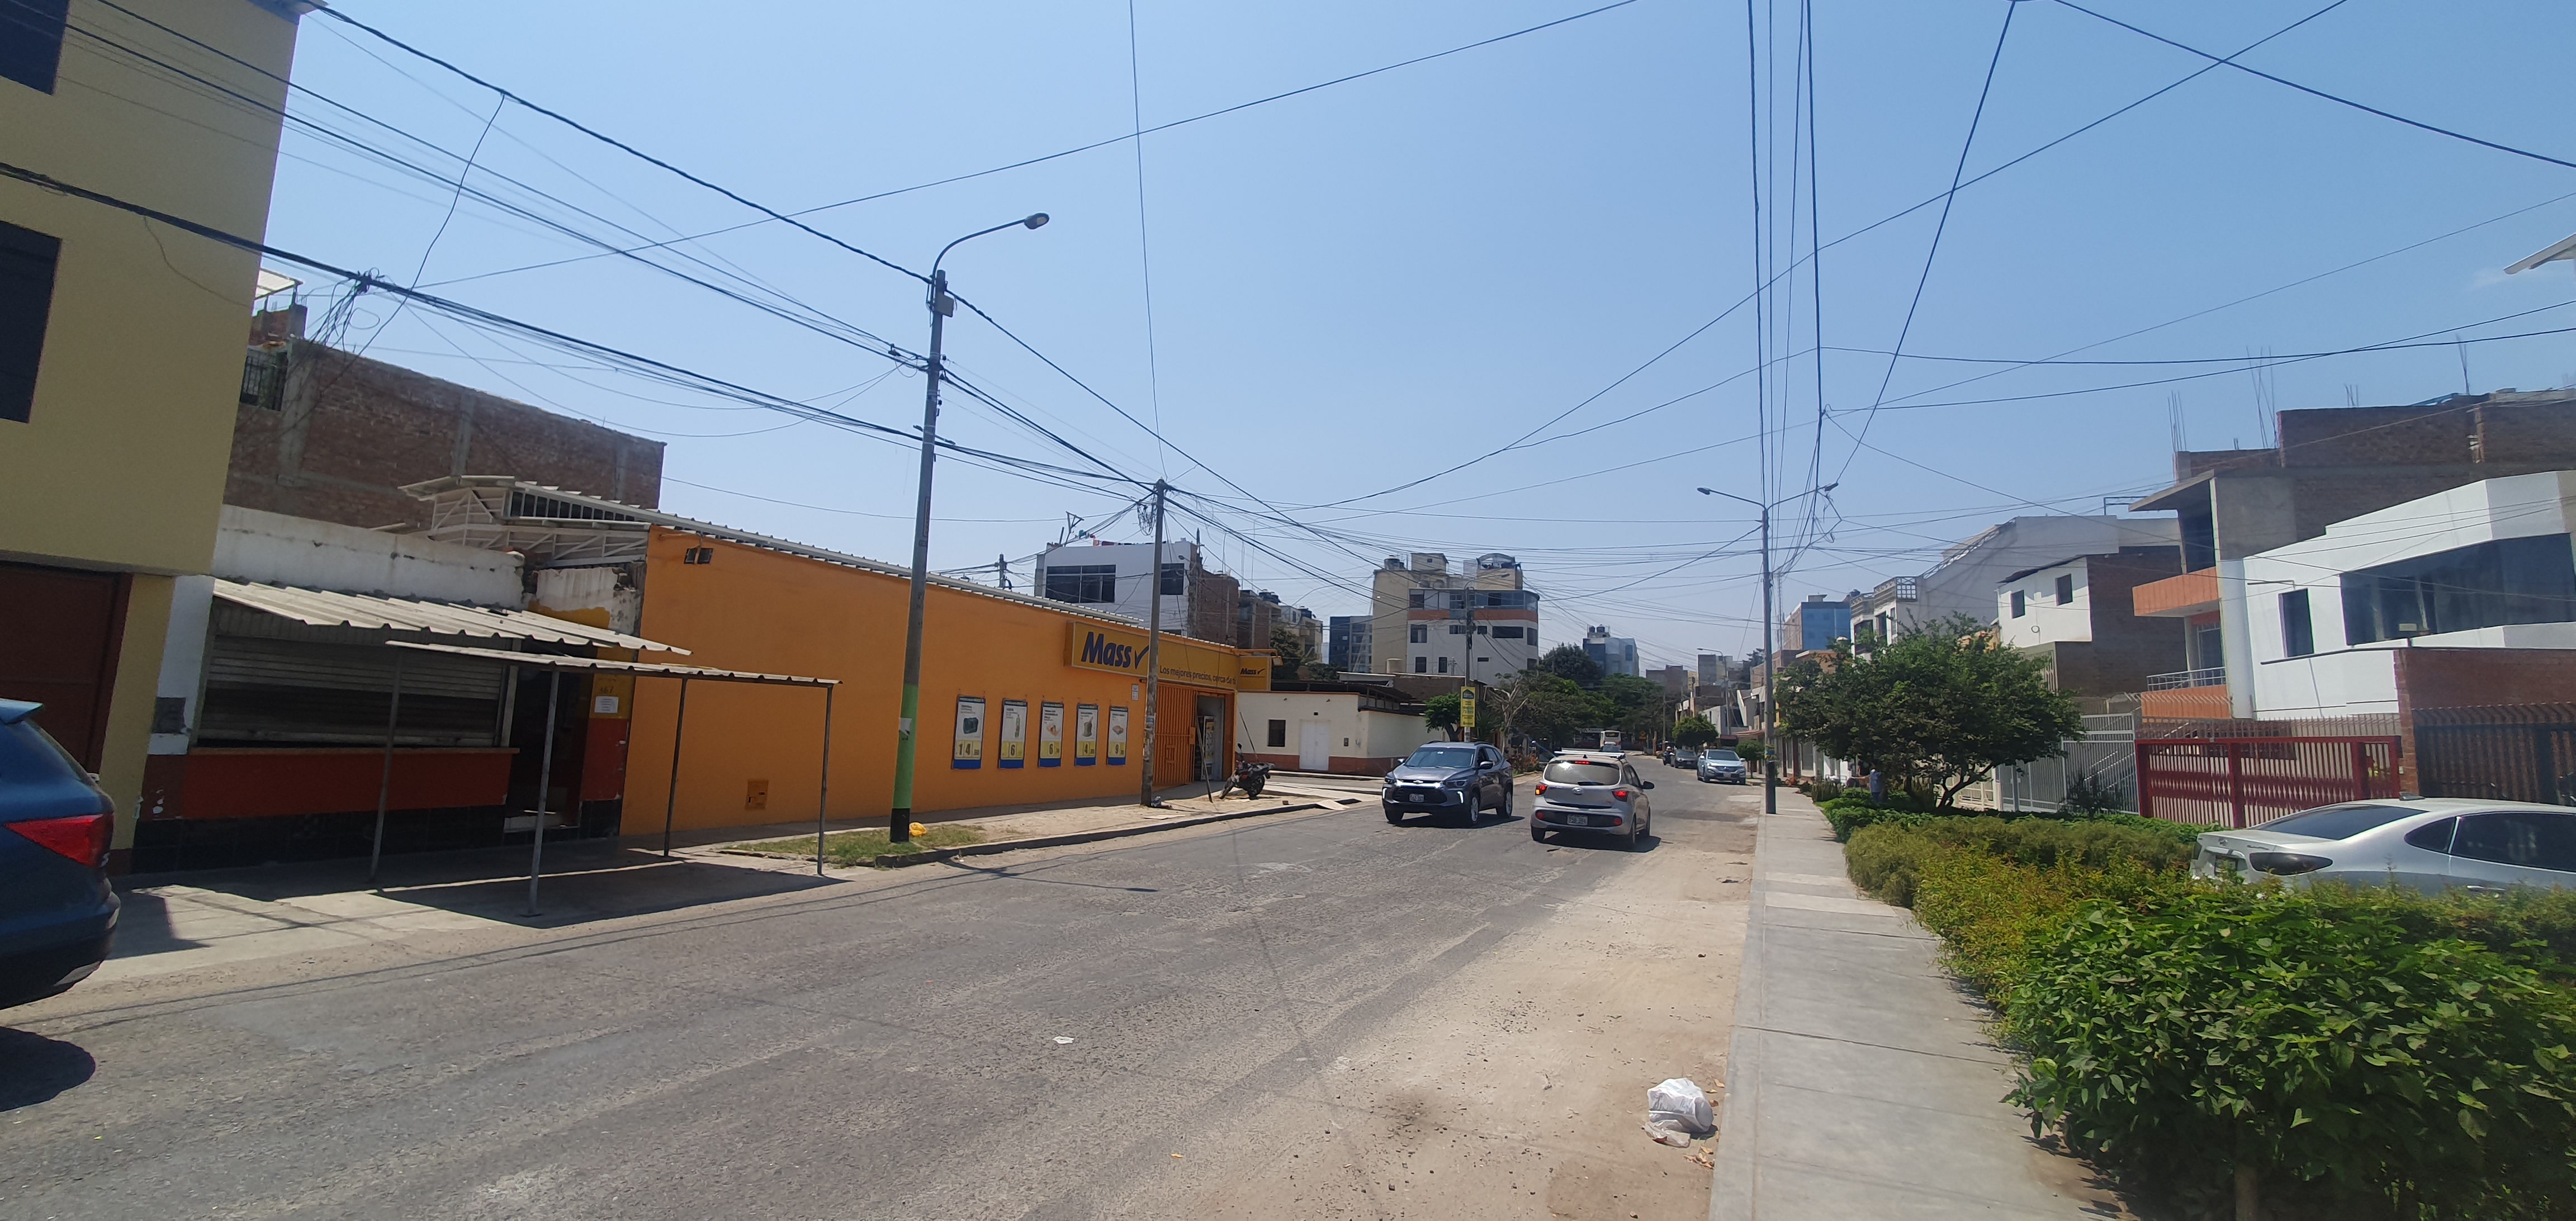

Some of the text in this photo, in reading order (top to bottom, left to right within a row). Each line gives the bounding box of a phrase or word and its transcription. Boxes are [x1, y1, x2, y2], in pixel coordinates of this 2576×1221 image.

[1081, 631, 1132, 668] Mass
[1159, 665, 1170, 675] Los
[1171, 668, 1192, 679] mejores
[1213, 675, 1226, 684] cerca
[1010, 744, 1015, 756] 6
